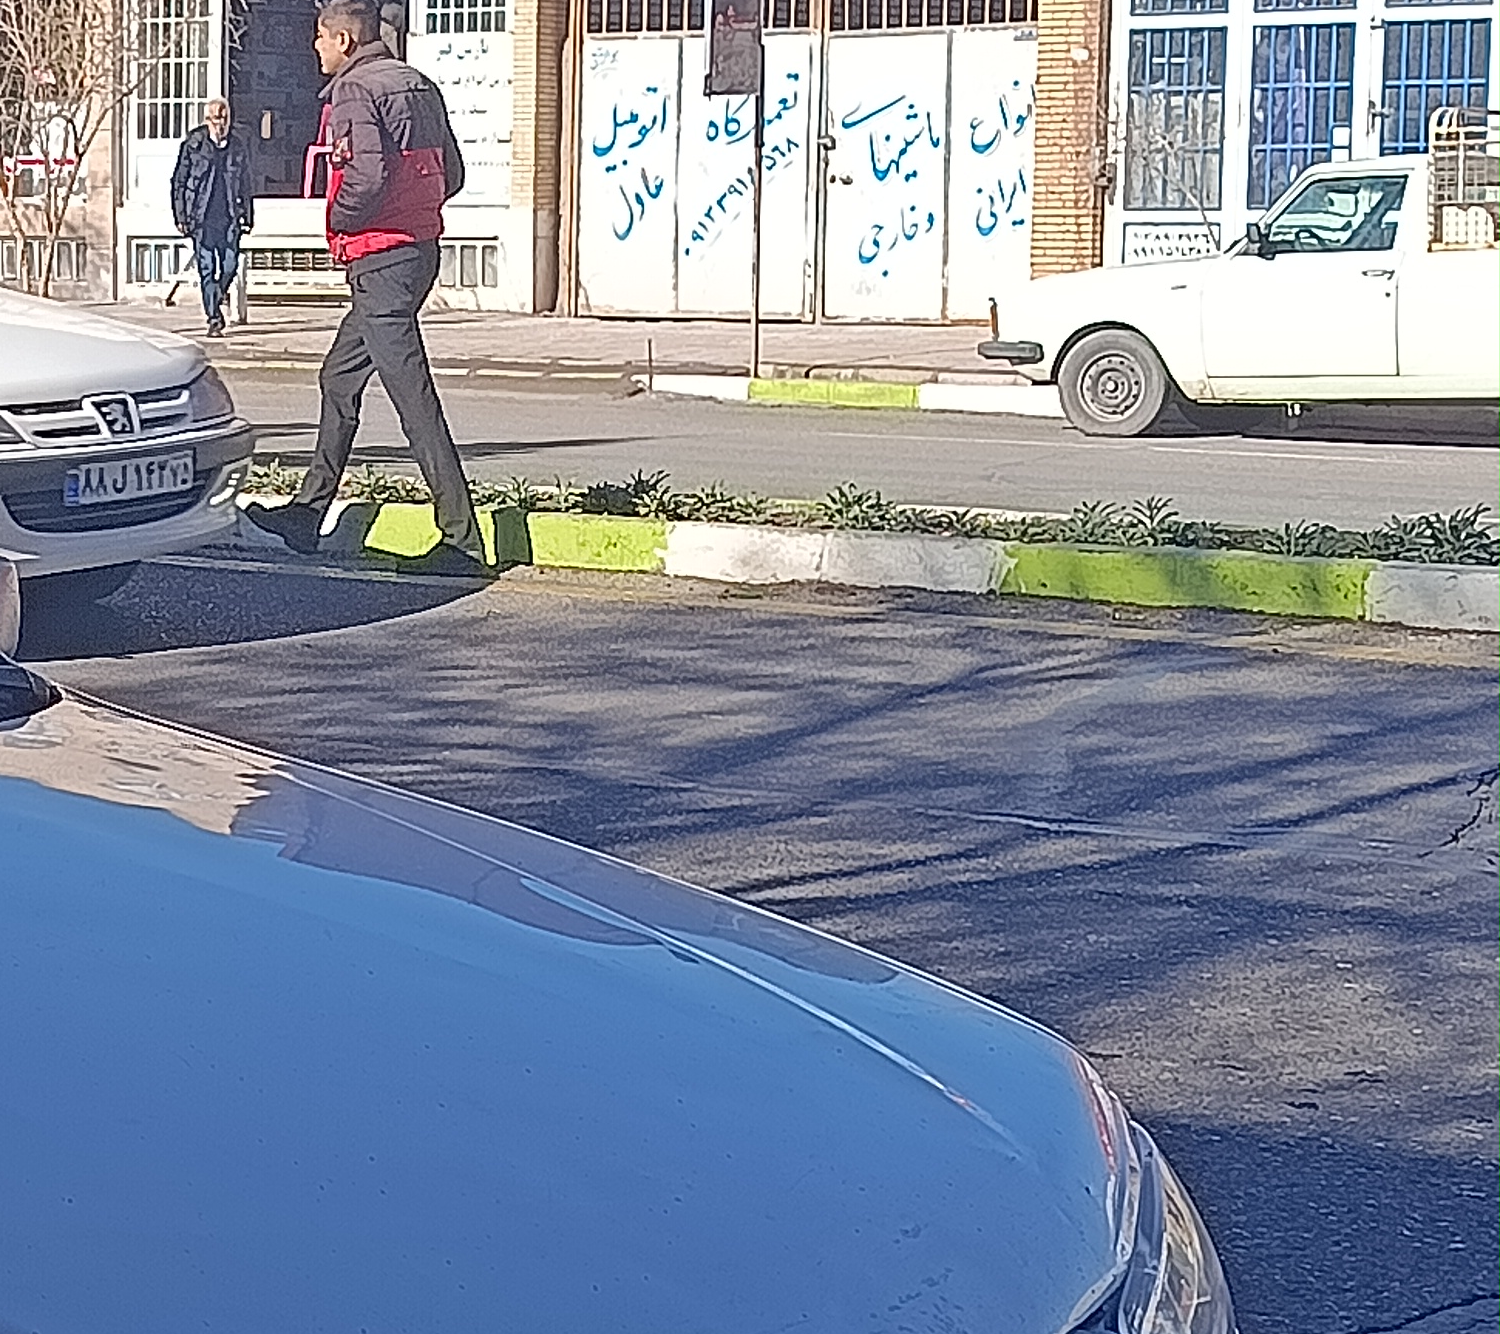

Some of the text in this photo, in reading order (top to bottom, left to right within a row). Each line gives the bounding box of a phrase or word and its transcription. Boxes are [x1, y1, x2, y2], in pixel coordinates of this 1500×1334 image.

[593, 87, 667, 173] اتومبیل
[970, 80, 1036, 155] انواع
[976, 169, 1026, 237] ایرانی
[82, 466, 108, 498] ۸۸
